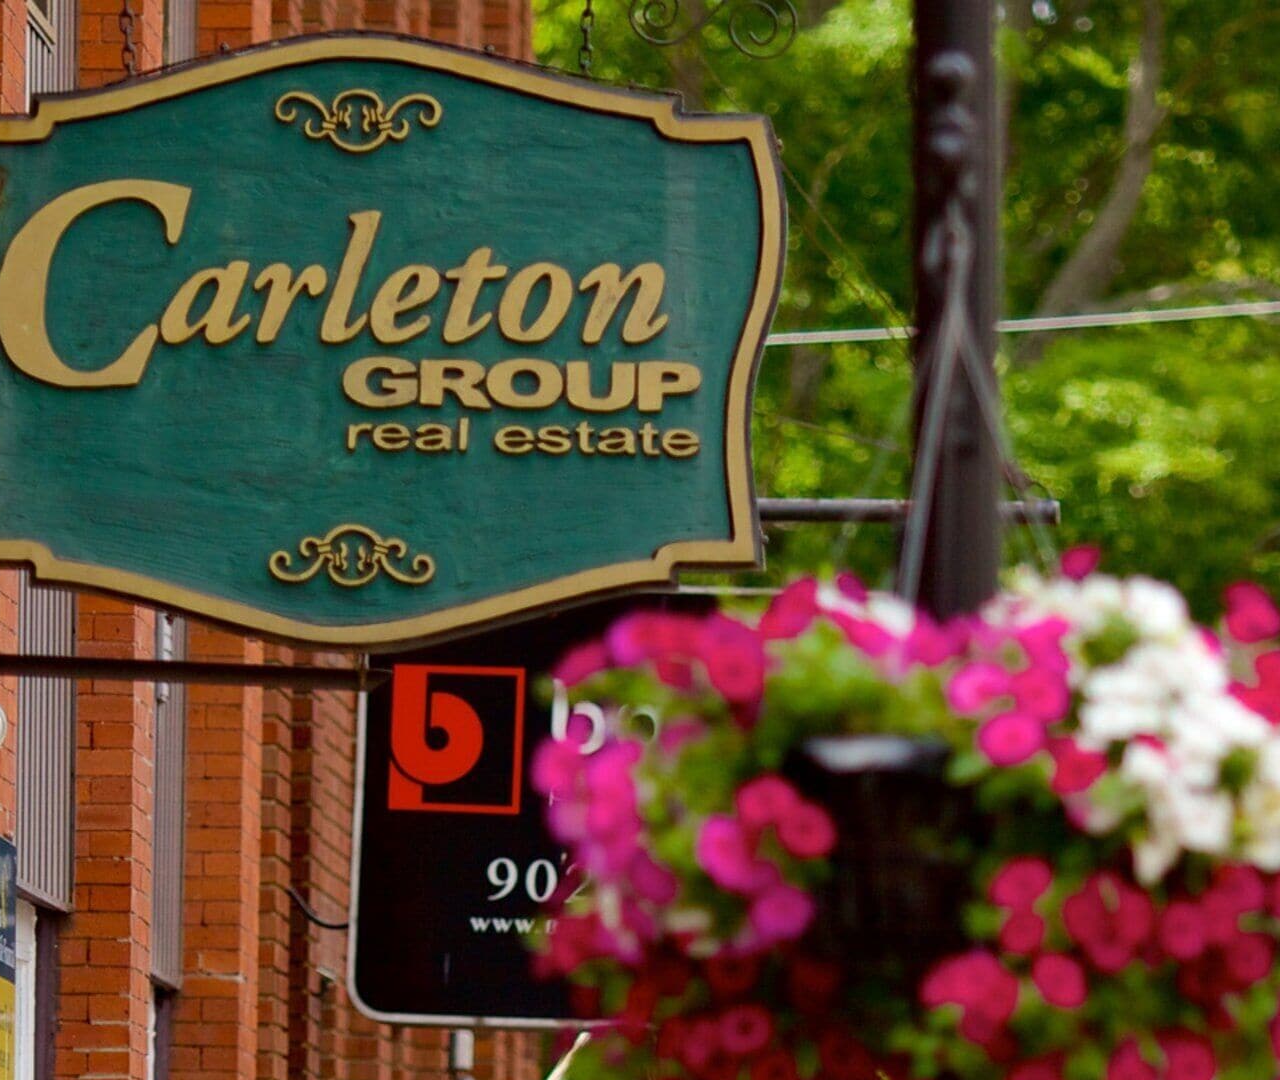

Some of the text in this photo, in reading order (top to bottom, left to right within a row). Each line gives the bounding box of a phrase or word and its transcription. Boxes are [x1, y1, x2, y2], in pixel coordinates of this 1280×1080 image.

[342, 356, 701, 413] GROUP
[346, 418, 700, 458] real estate
